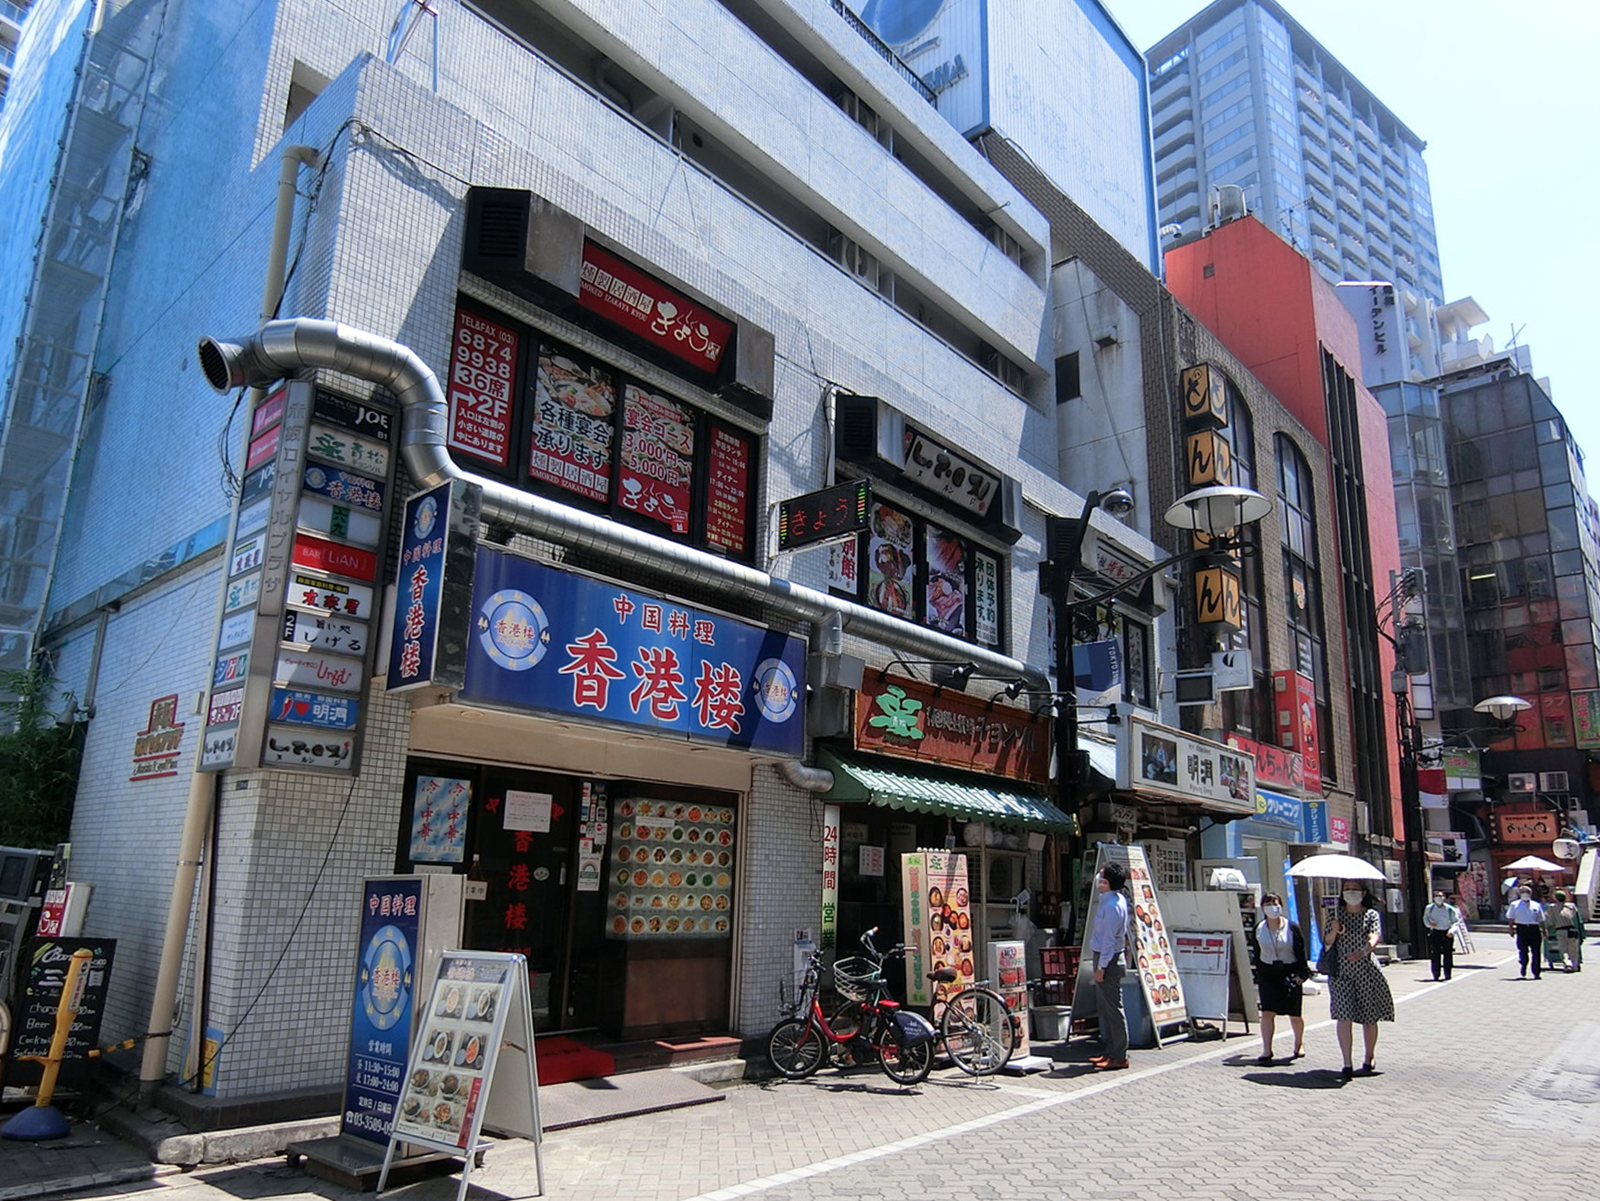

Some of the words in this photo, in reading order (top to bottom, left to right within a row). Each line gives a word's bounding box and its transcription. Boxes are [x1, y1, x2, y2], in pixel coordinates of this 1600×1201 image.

[581, 282, 603, 297] MOKED
[604, 294, 629, 313] IZAKAYA
[630, 307, 649, 322] KYOU
[459, 328, 512, 362] 6874
[460, 314, 497, 337] TEL&FAX
[499, 329, 515, 346] (03)
[457, 346, 511, 379] 9938
[457, 366, 508, 399] 36席
[355, 406, 389, 429] JOE
[458, 407, 506, 430] 入口は左側の
[477, 395, 507, 419] 2F
[538, 400, 611, 446] 各種宴会
[377, 431, 388, 440] B1
[456, 432, 504, 453] 中にあります
[457, 420, 505, 442] 小さい道路の
[626, 407, 691, 450] 宴会コース
[535, 426, 608, 469] 承ります
[531, 469, 560, 485] SMOKED
[561, 480, 589, 496] IZAKAYA
[630, 455, 680, 487] 5,000円
[265, 402, 306, 593] 赤坂ロイヤルプラザ
[326, 480, 383, 511] 香港楼
[790, 498, 849, 536] きょう
[302, 547, 321, 559] BAR
[403, 537, 442, 566] 中国料理
[284, 614, 296, 639] 2F
[399, 565, 429, 677] 香港楼
[494, 619, 535, 641] 香港楼
[612, 593, 717, 646] 中国料理
[304, 631, 362, 651] しげる
[558, 628, 746, 735] 香港楼
[312, 703, 348, 722] 明洞
[1187, 753, 1214, 787] 明洞
[417, 780, 441, 842] 冷し中華
[443, 782, 466, 844] 冷し中華
[1267, 799, 1300, 818] クリーニング
[1310, 808, 1321, 842] クリーニング
[504, 831, 535, 929] 香港楼
[821, 825, 838, 951] 24時間営業
[369, 894, 417, 916] 中国料理
[372, 967, 400, 987] 香港楼
[26, 1018, 50, 1029] Beer
